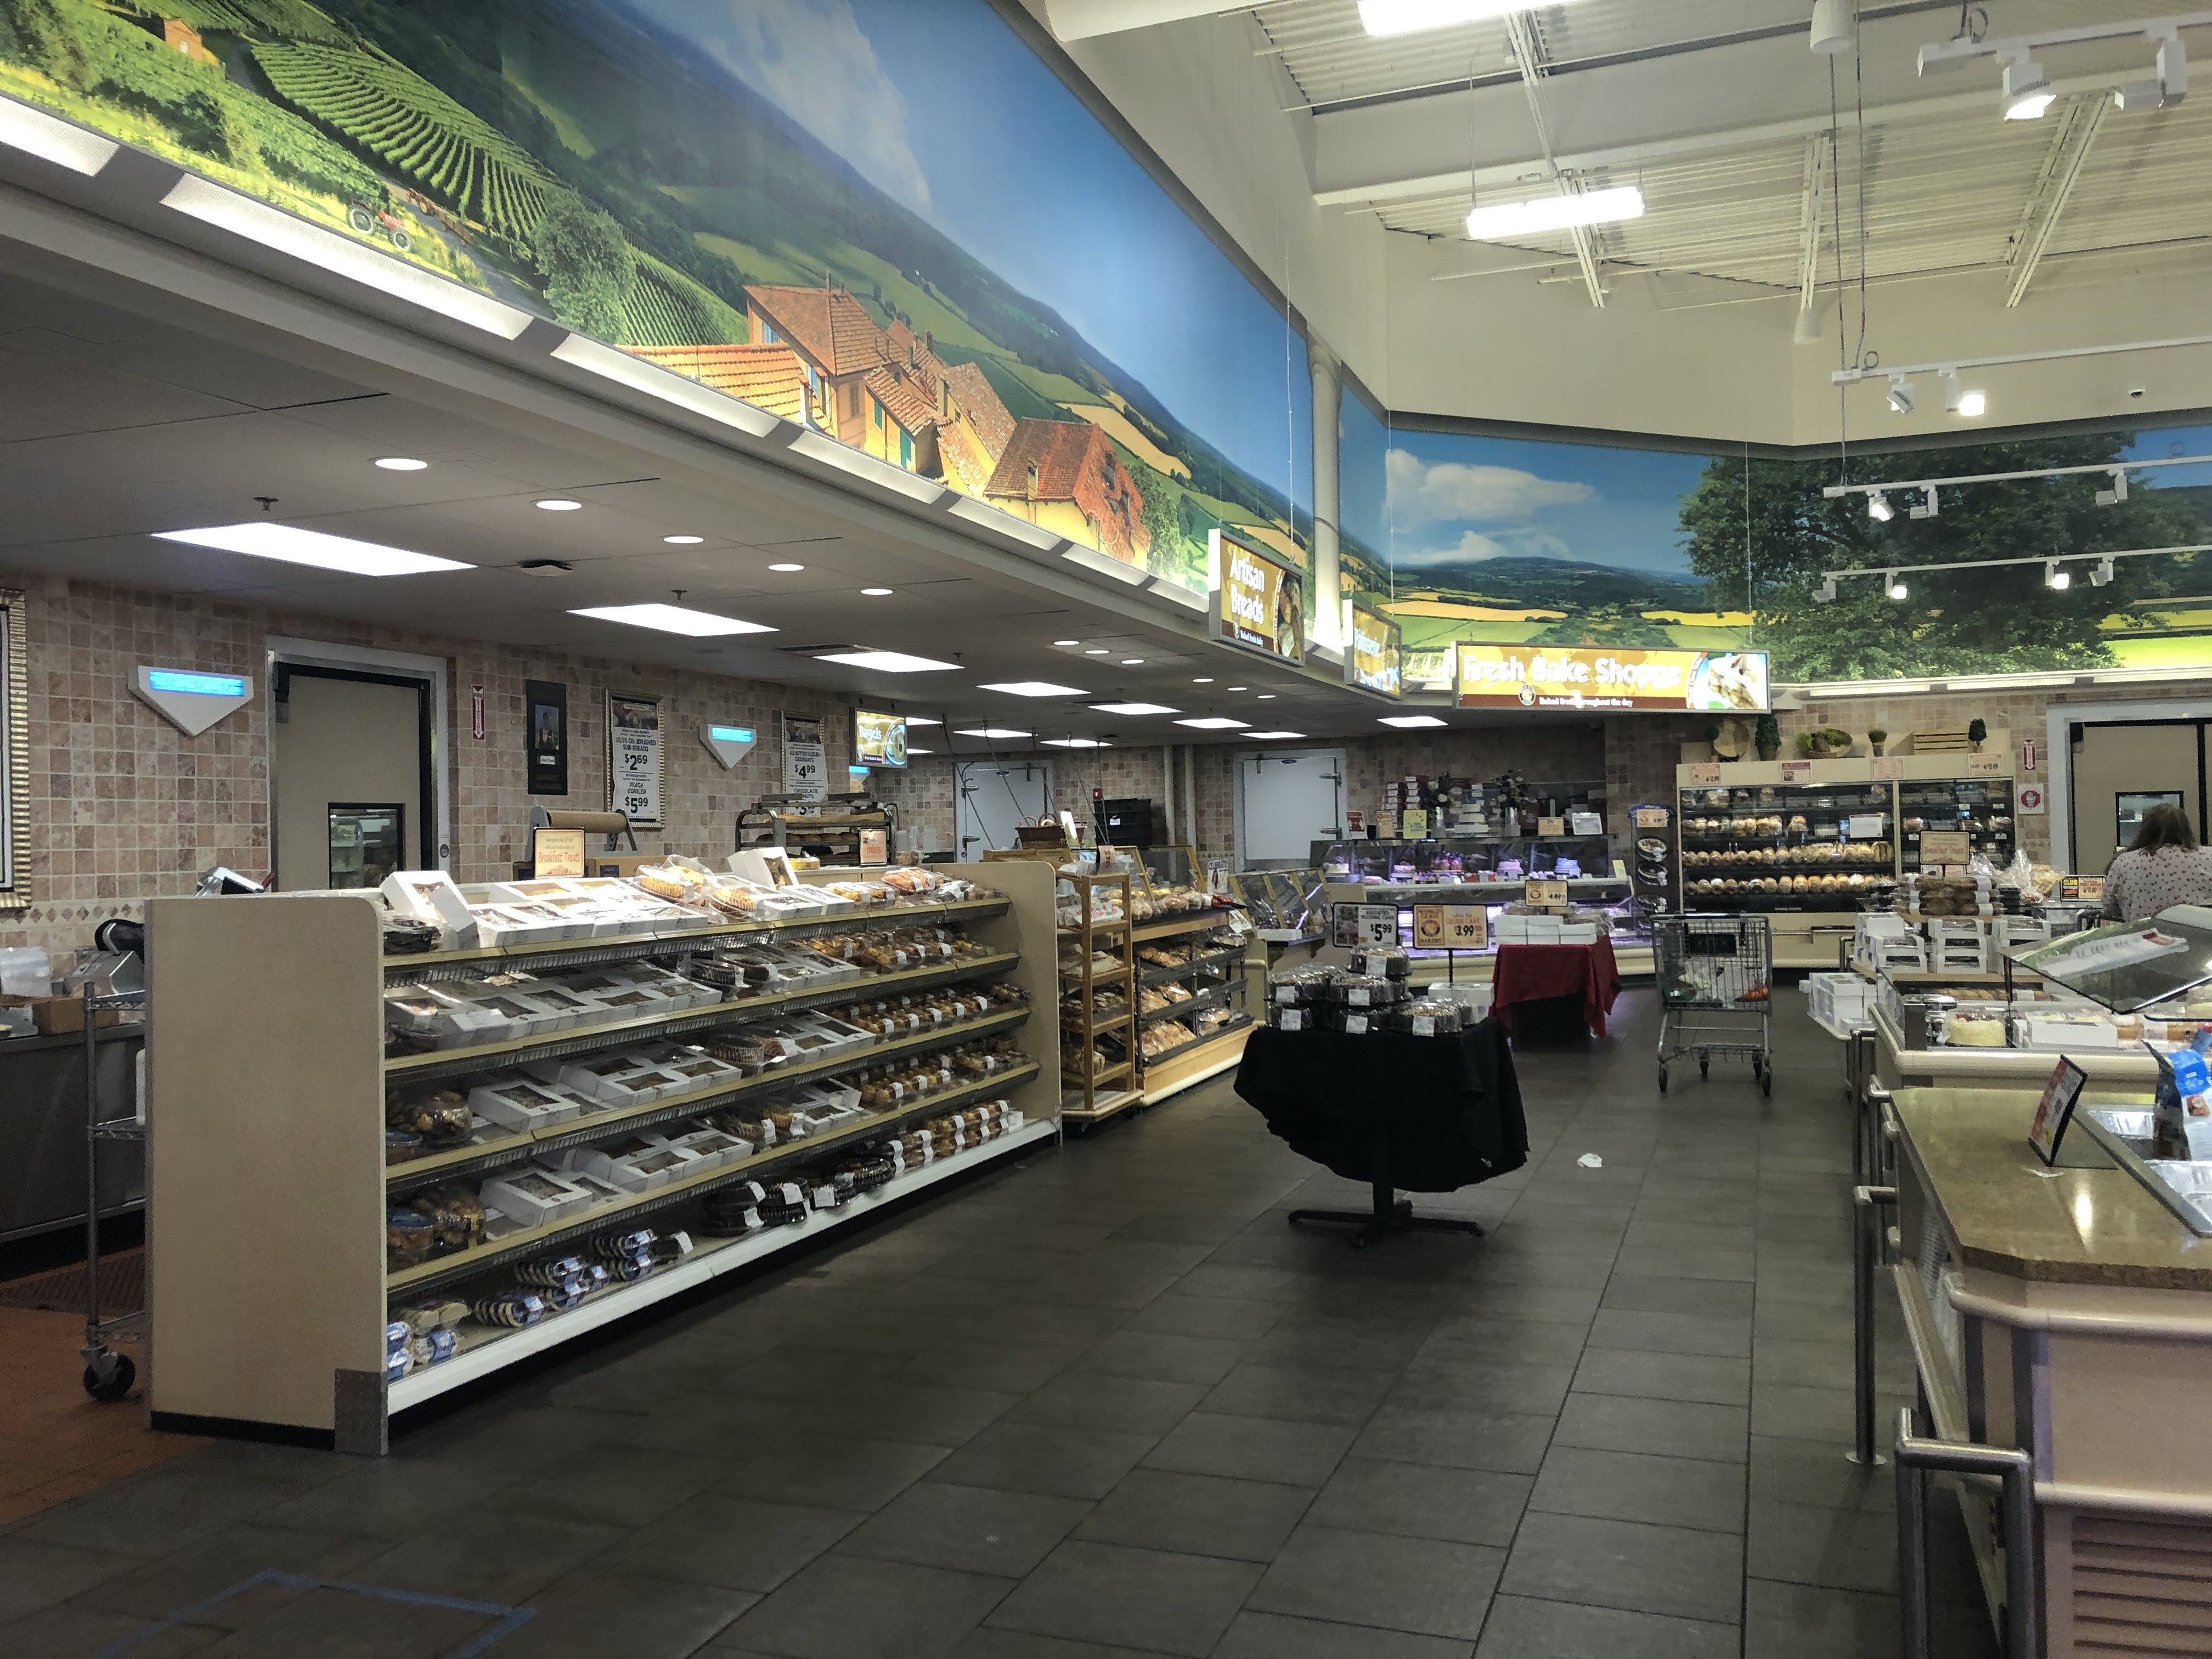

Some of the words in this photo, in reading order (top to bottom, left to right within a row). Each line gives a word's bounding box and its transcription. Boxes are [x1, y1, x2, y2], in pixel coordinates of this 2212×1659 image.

[1229, 549, 1265, 592] Artisan
[1231, 583, 1264, 624] Breads
[1463, 655, 1525, 682] Fresh
[1532, 656, 1589, 683] Bake
[1594, 657, 1681, 690] Shoppe
[859, 725, 882, 742] Bagels
[539, 850, 562, 864] Breakfast
[564, 851, 580, 863] Treats
